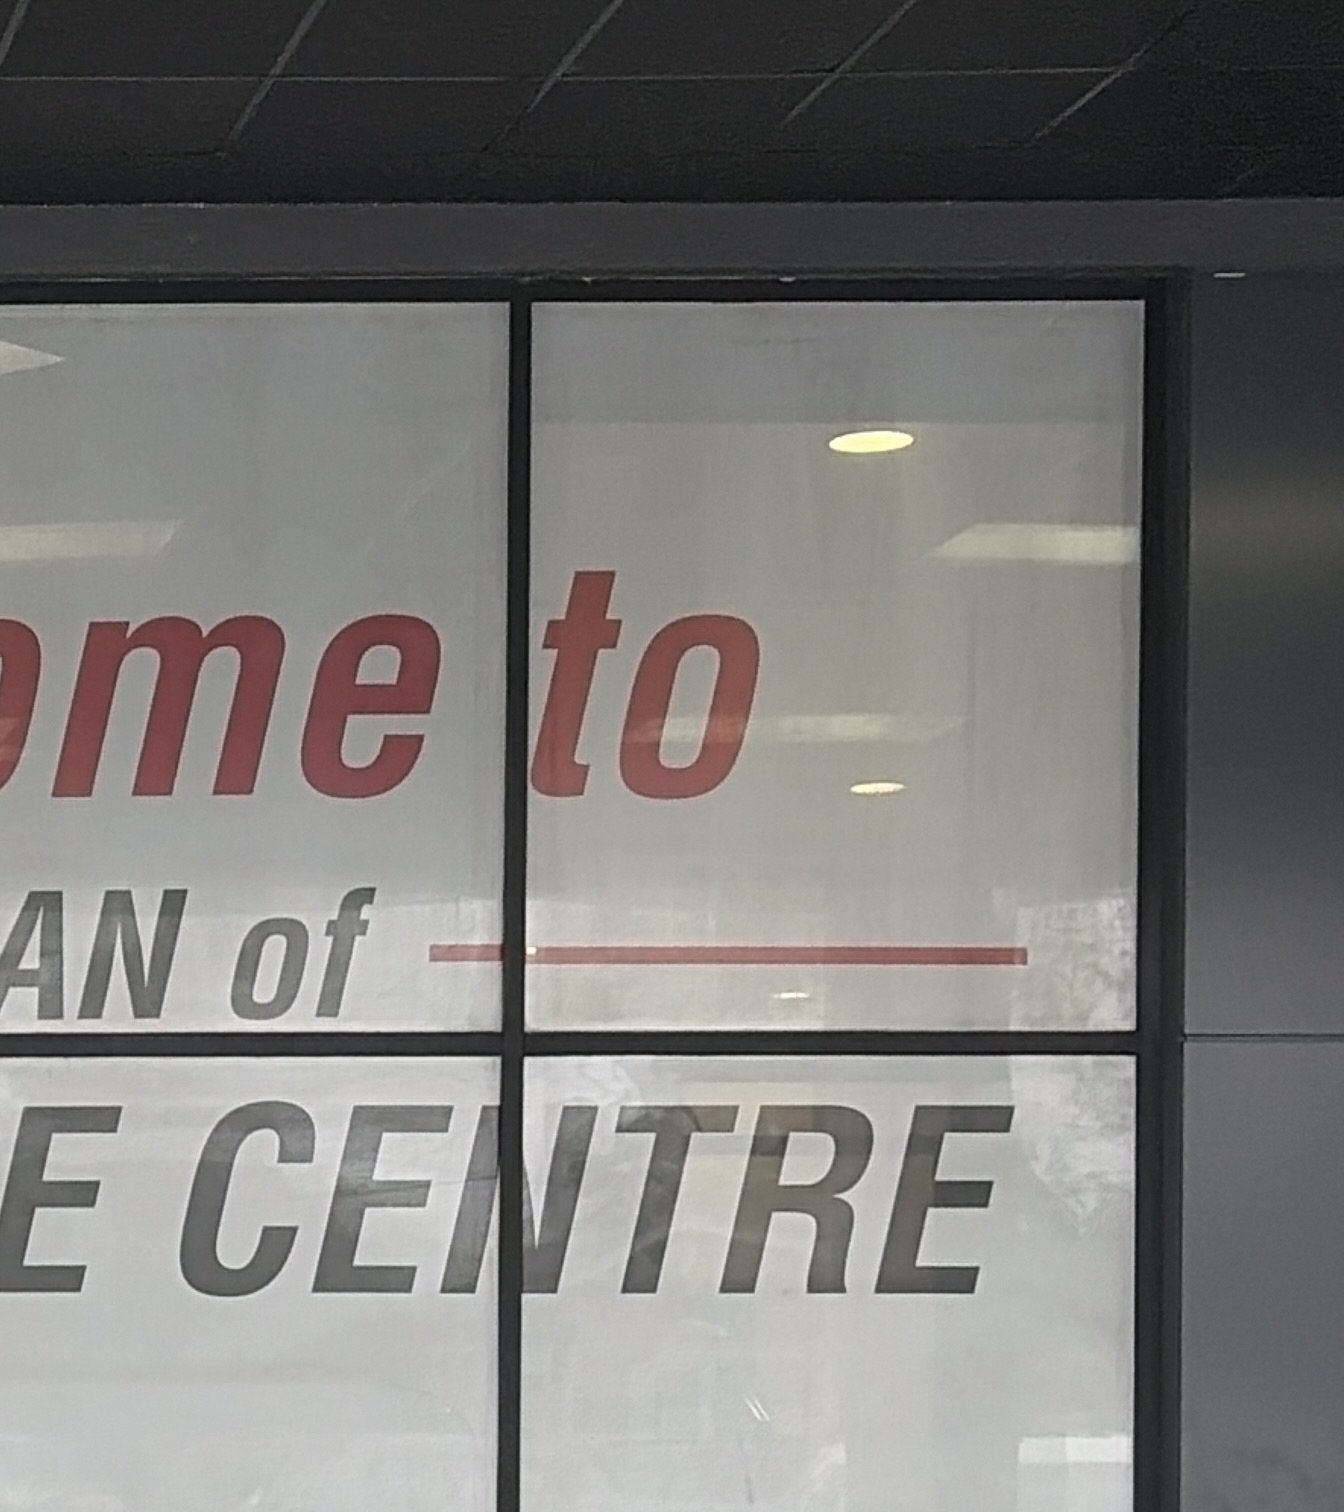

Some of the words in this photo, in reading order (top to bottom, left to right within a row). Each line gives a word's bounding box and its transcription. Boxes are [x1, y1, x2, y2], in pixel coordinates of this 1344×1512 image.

[529, 570, 761, 799] to
[230, 886, 377, 1020] of
[176, 1103, 1016, 1300] CENTRE
